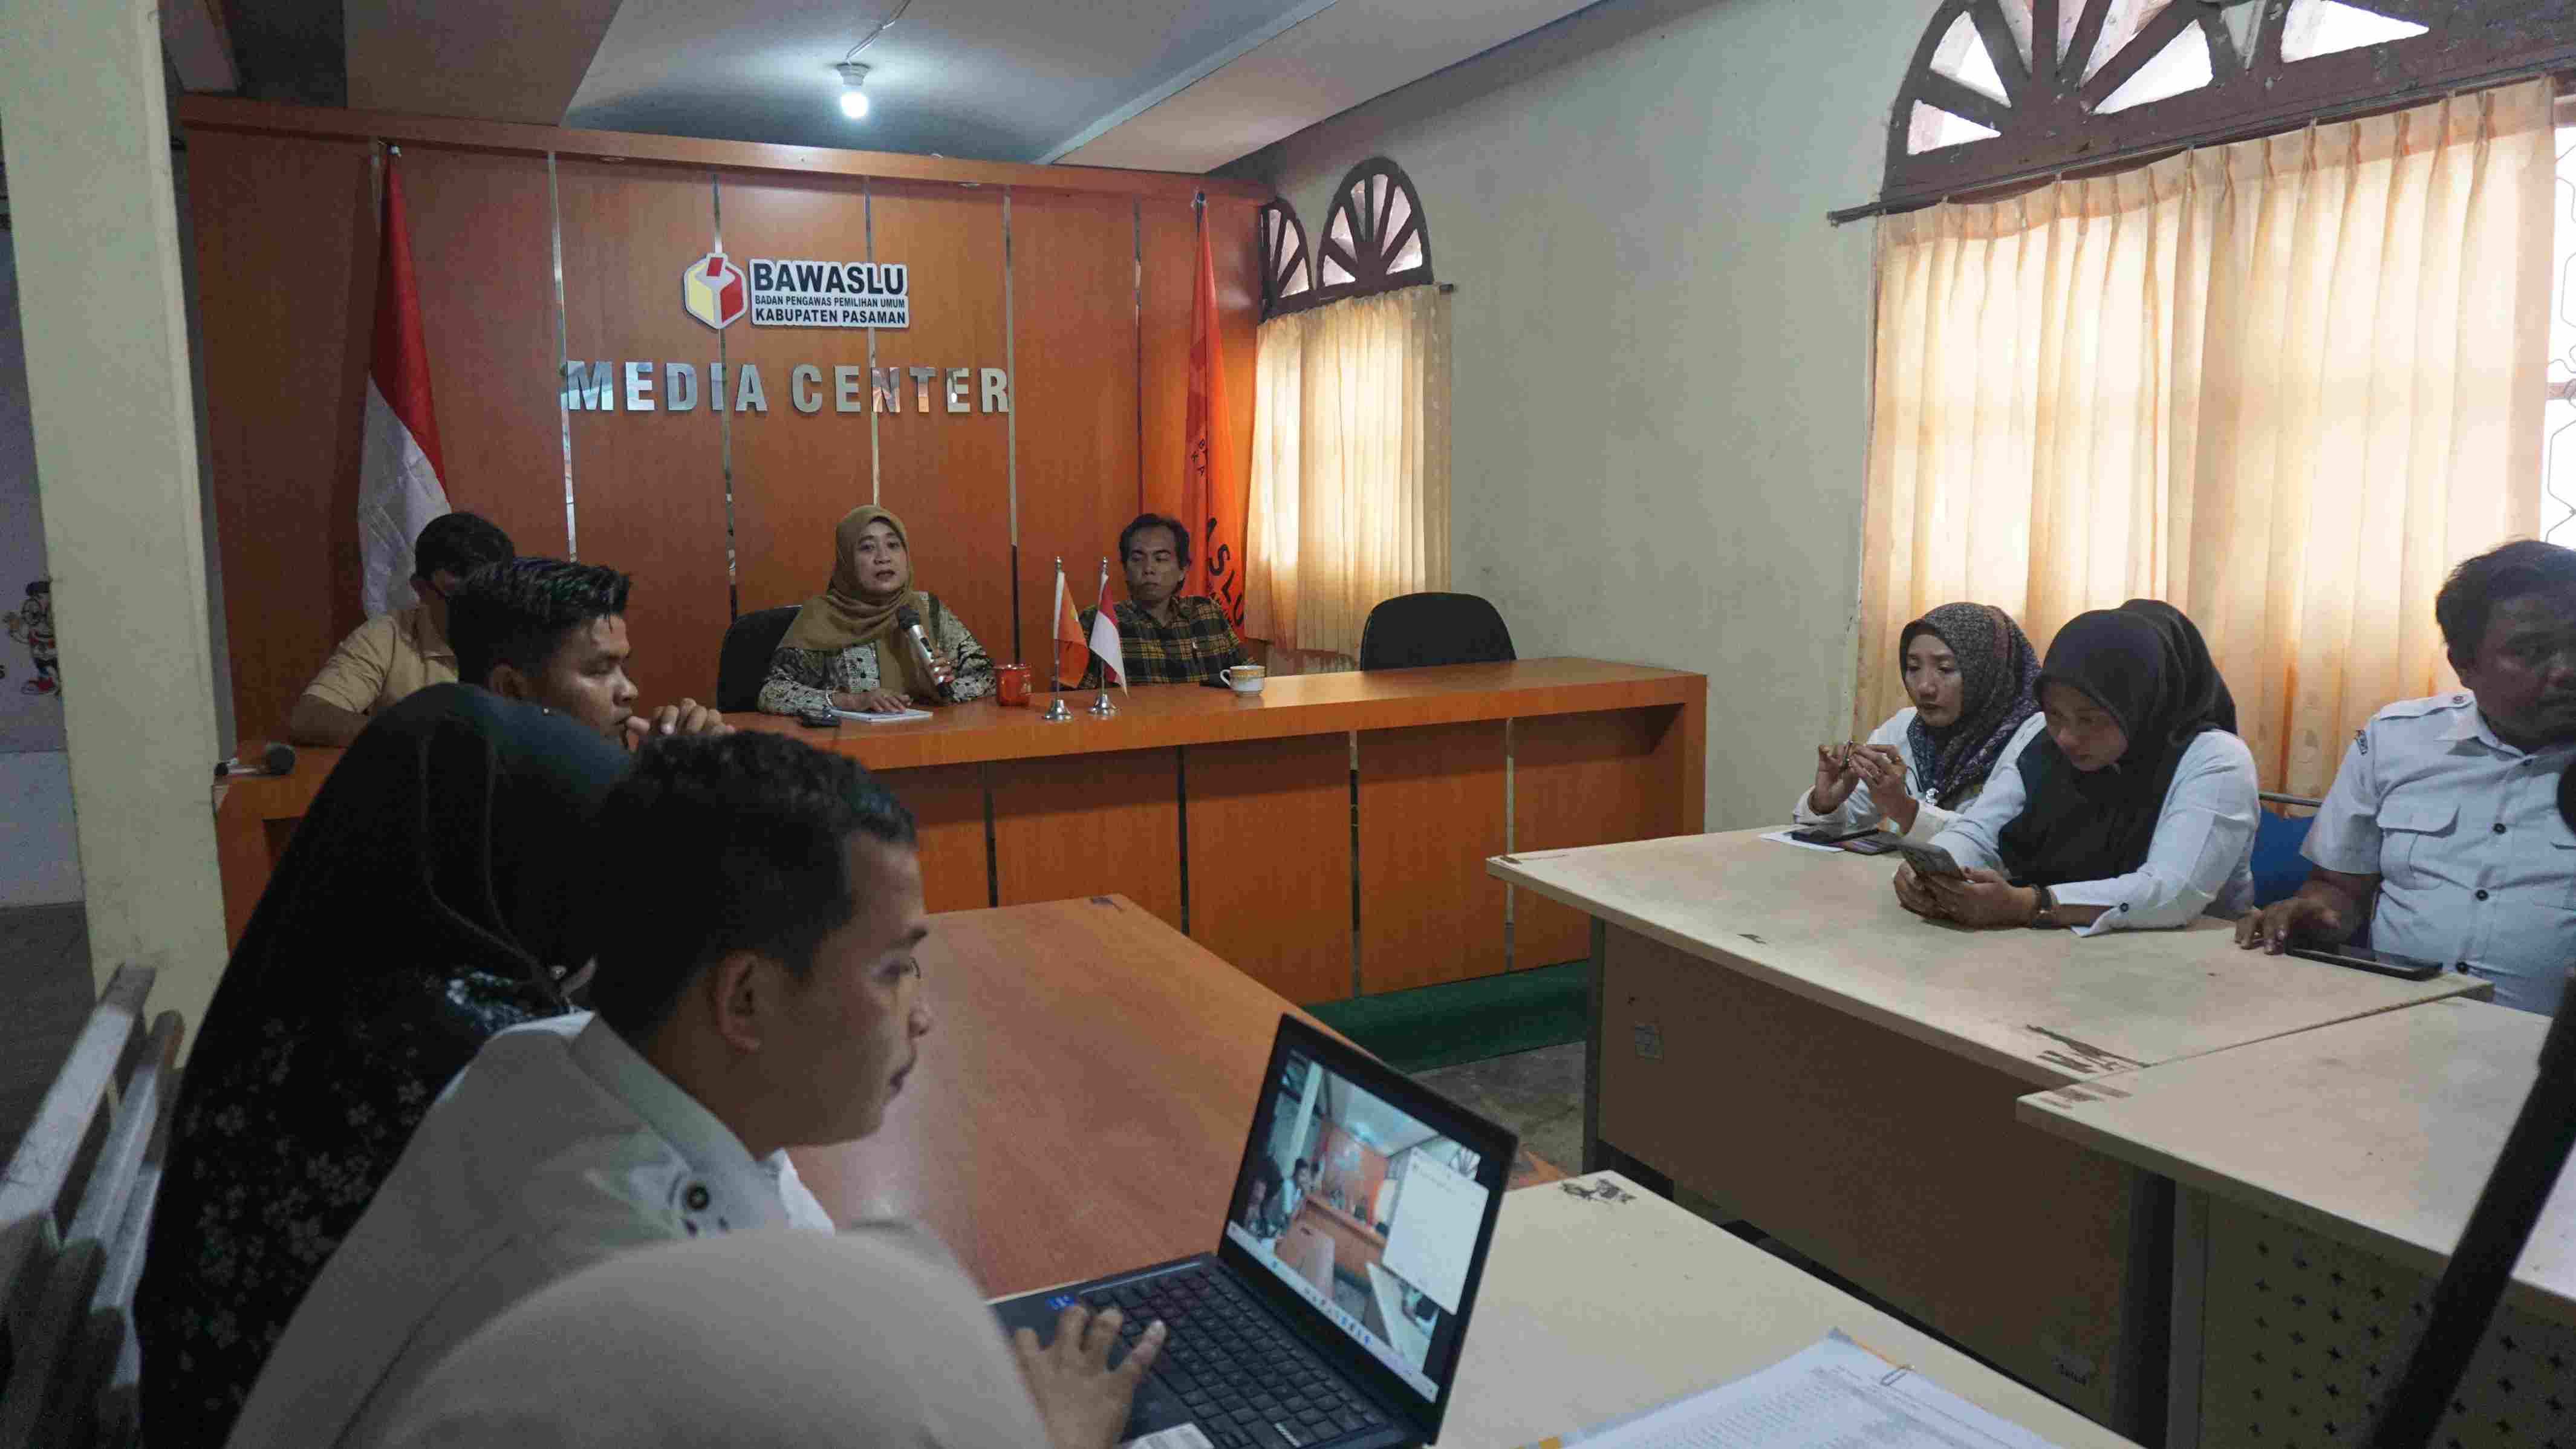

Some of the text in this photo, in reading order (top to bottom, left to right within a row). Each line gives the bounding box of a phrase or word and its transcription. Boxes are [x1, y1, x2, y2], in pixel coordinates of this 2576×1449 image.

[754, 263, 903, 295] BAWASLU
[755, 295, 783, 305] BADAN
[785, 296, 831, 306] PENGAWAS
[834, 298, 877, 307] PEMILIHAN
[756, 308, 905, 324] KABUPATEN PASAMAN
[566, 361, 1009, 412] MEDIA CENTER
